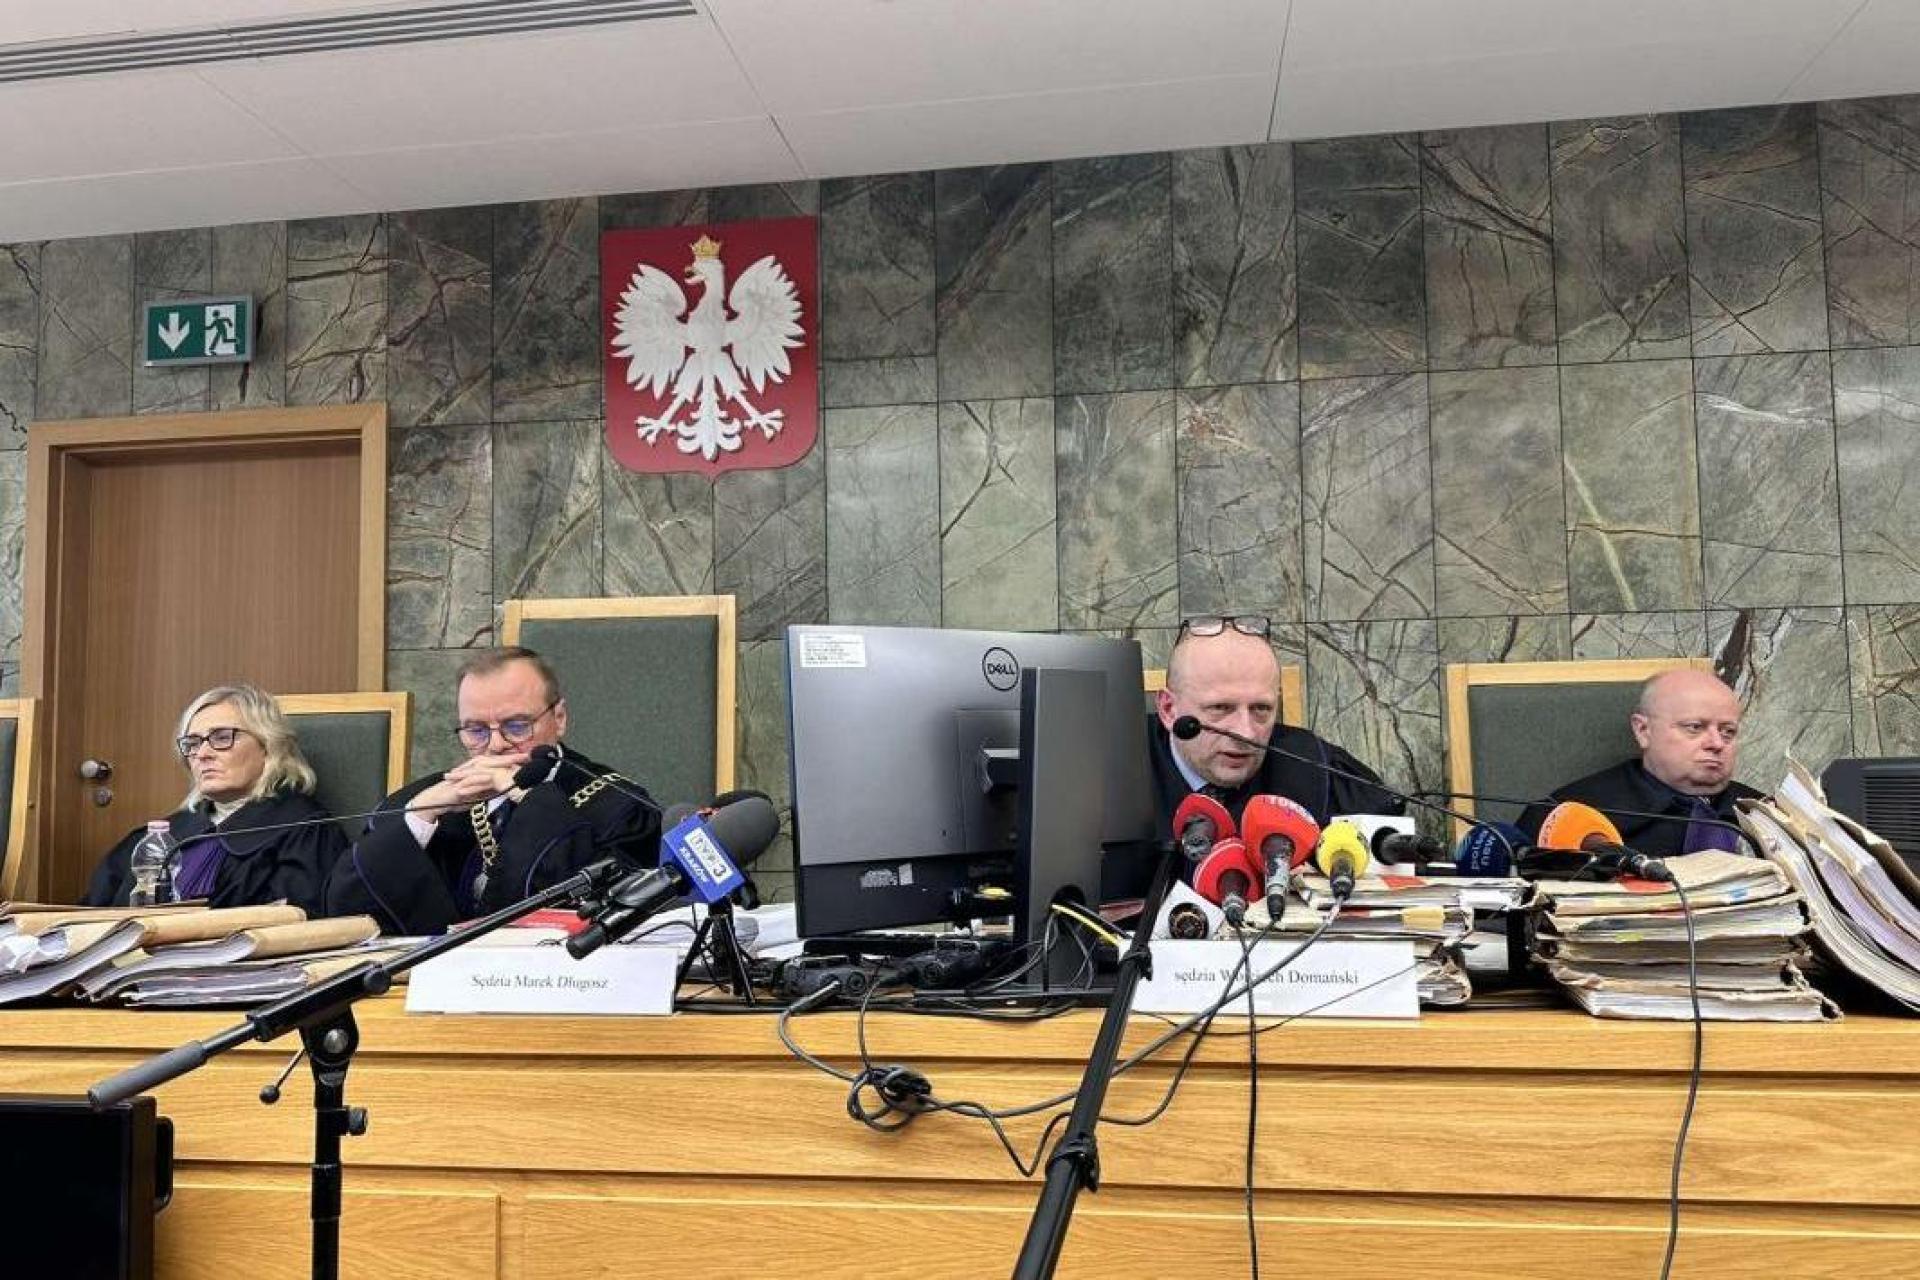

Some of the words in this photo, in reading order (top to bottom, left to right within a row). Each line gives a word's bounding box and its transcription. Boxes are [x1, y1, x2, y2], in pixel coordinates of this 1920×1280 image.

[987, 662, 1017, 675] DELL
[472, 974, 511, 990] Sędzia
[514, 974, 554, 989] Marek
[558, 975, 609, 992] Długosz
[1174, 968, 1216, 984] sędzia
[1289, 969, 1358, 984] Domański
